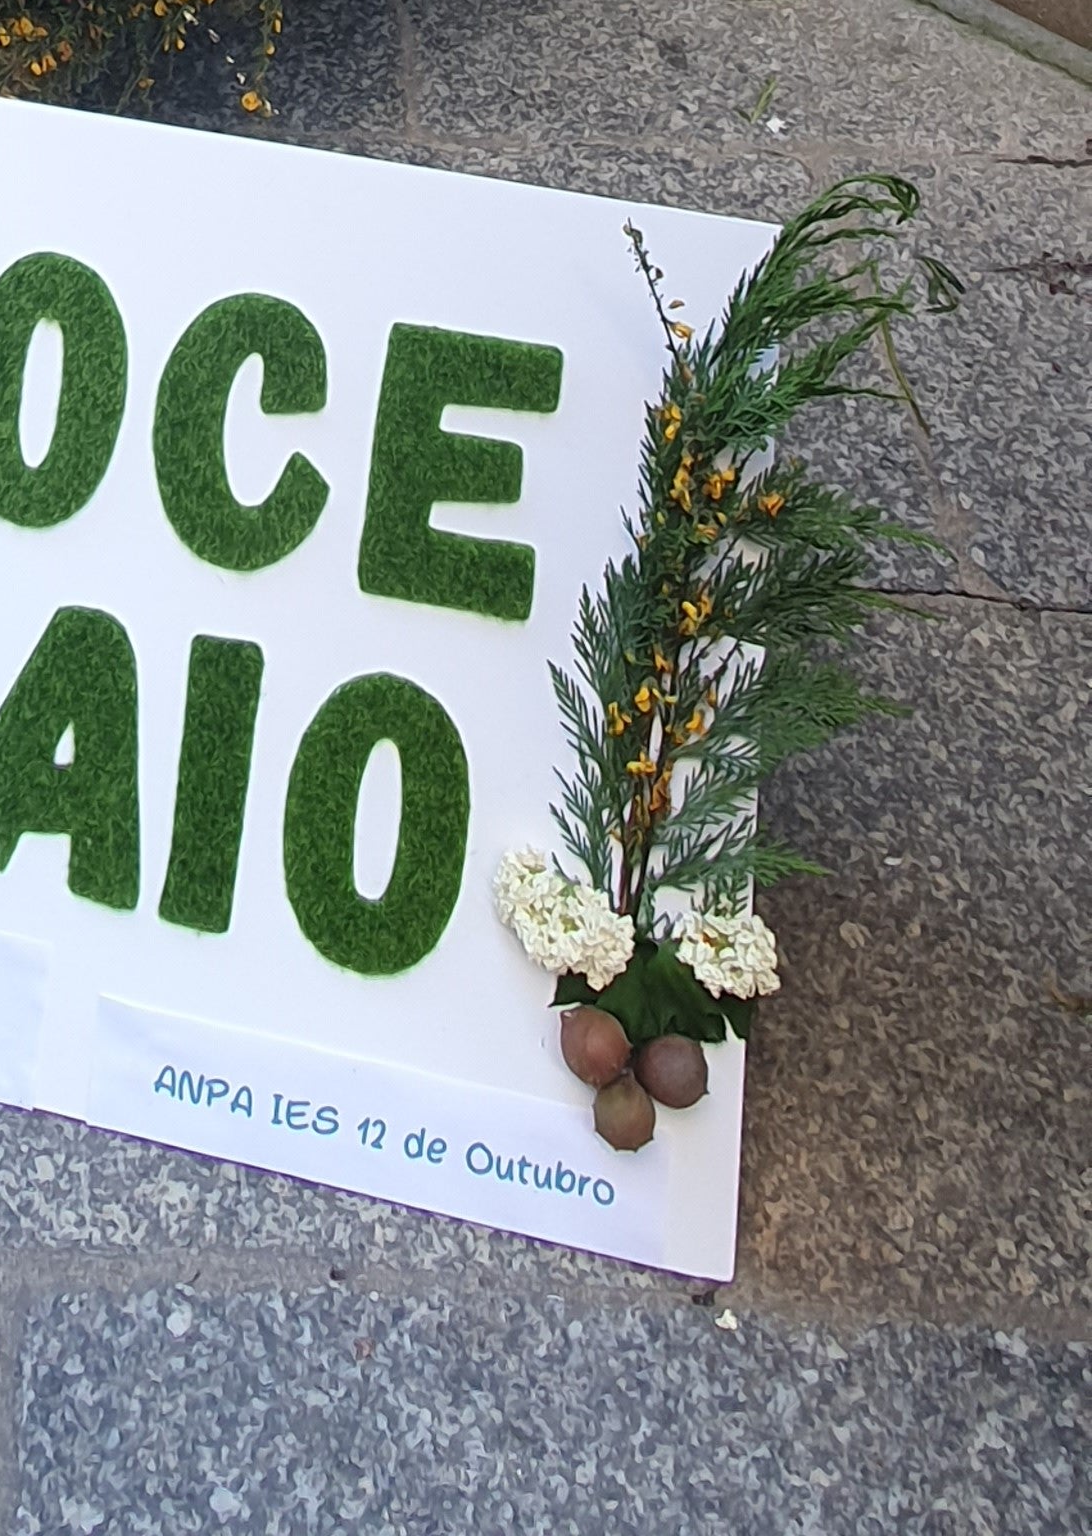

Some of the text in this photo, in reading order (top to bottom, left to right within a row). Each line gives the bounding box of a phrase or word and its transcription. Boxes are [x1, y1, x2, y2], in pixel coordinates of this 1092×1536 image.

[154, 1065, 616, 1206] ANPA IES 12 de Outubro
